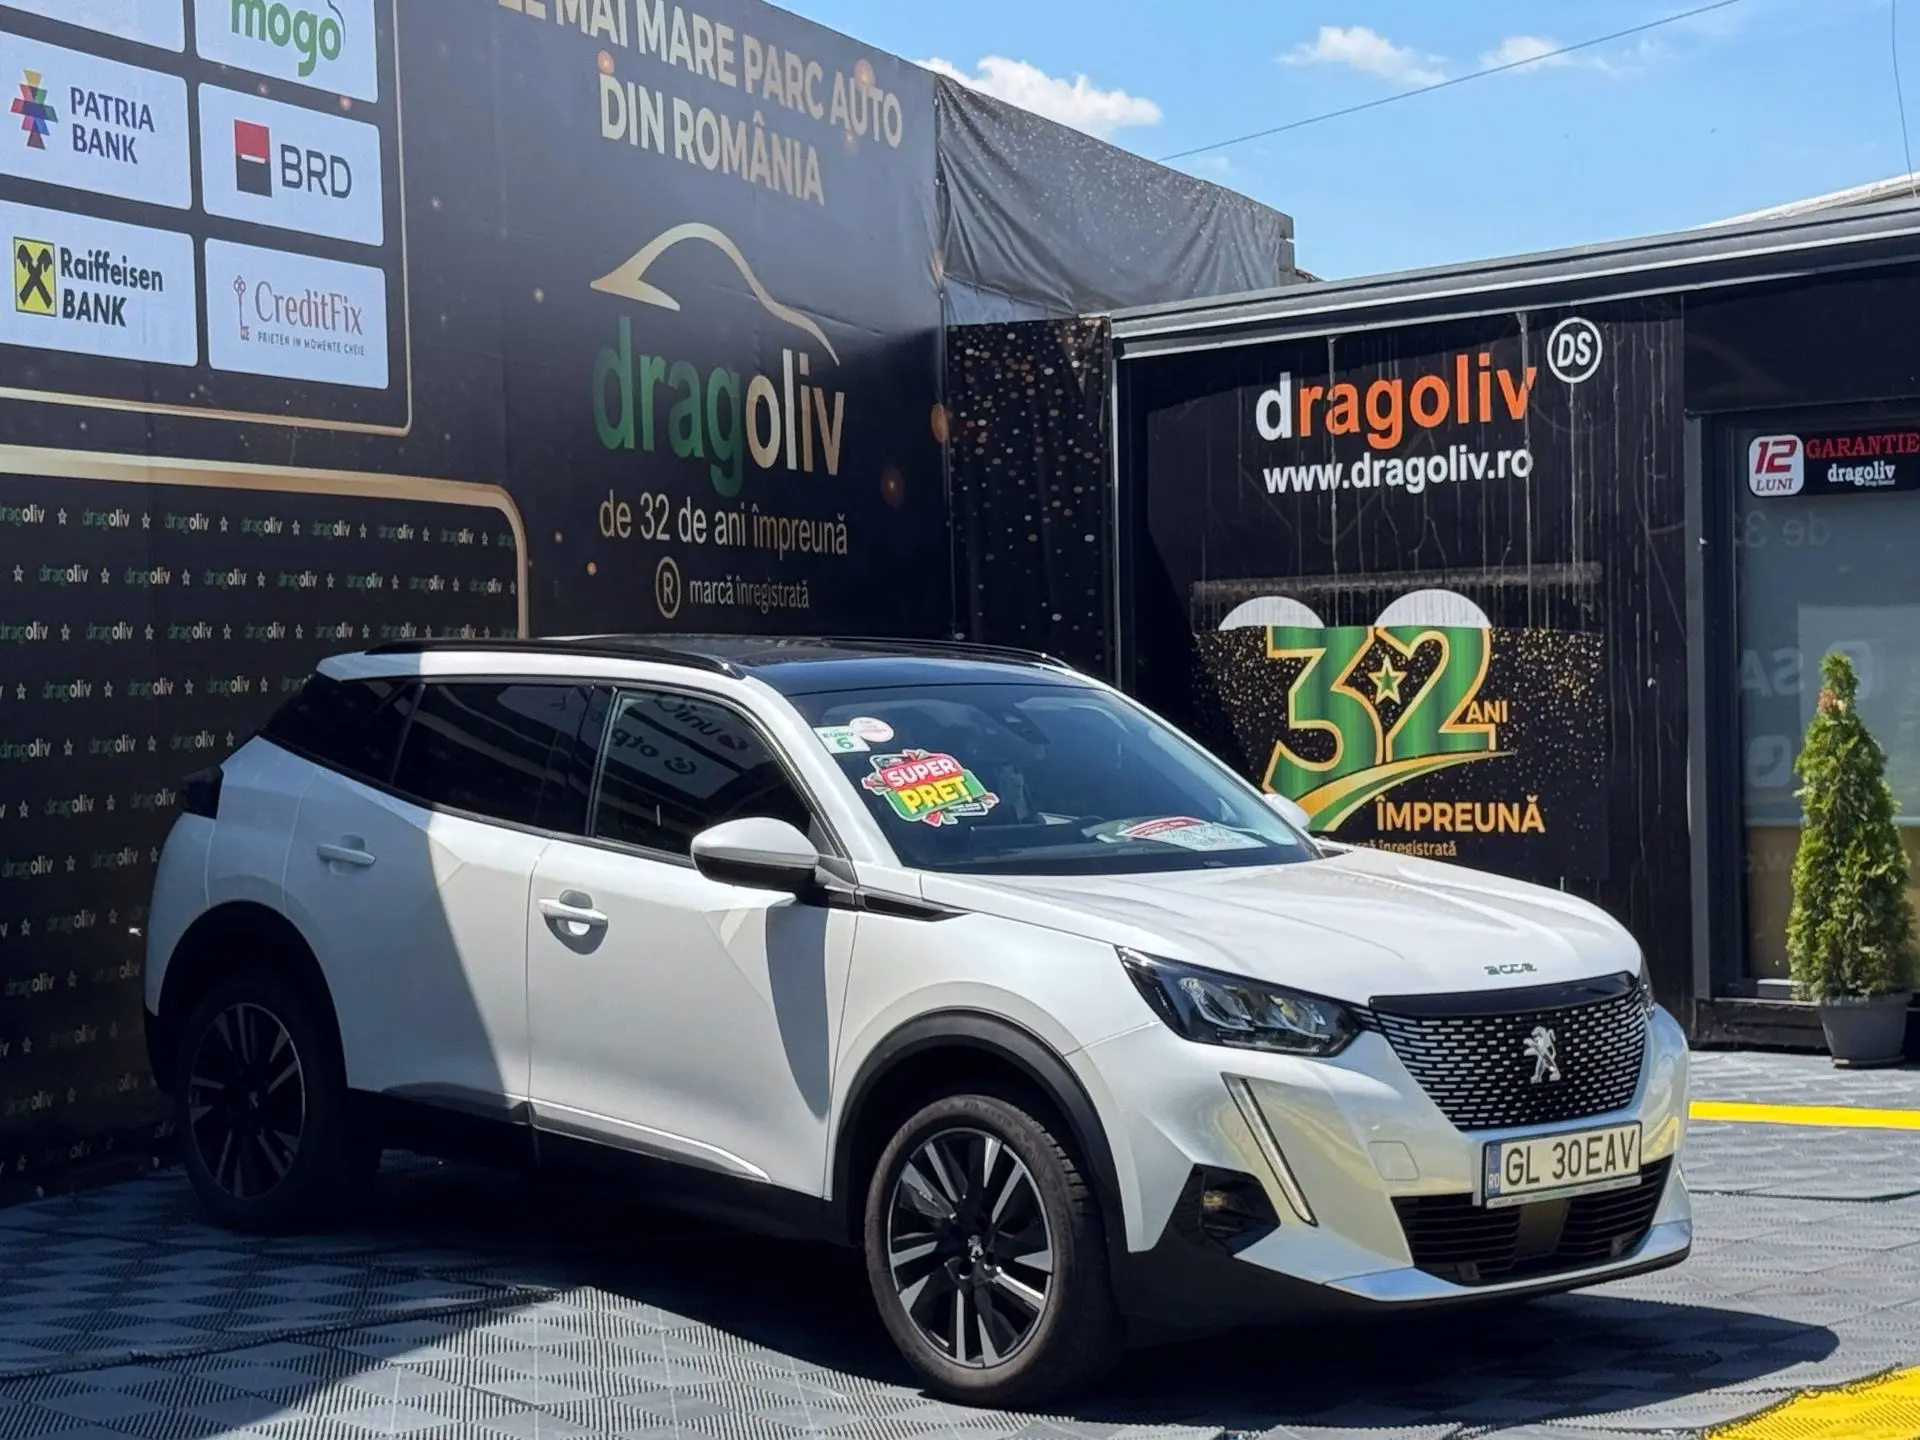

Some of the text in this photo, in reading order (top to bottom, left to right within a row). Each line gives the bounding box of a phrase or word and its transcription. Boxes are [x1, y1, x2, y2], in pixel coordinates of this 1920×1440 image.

[231, 0, 342, 77] mogo
[637, 0, 738, 89] MARE
[742, 32, 824, 121] PARC
[829, 70, 903, 149] AUTO
[70, 86, 156, 133] PATRIA
[72, 123, 139, 165] BANK
[599, 73, 825, 207] DIN ROMÂNIA
[280, 143, 353, 200] BRD
[60, 247, 164, 293] Raiffeisen
[62, 288, 127, 328] BANK
[255, 280, 364, 336] CreditFix
[1556, 330, 1594, 368] DS
[592, 315, 846, 497] dragoliv
[1255, 351, 1538, 450] dragoliv
[1754, 439, 1798, 475] 12
[1805, 431, 1920, 460] GARANTIE
[1263, 444, 1534, 495] www.dragoliv.ro
[1755, 477, 1795, 492] LUNI
[1827, 459, 1897, 487] dragoliv
[0, 503, 46, 528] ragoliv
[82, 506, 131, 532] dragoliv
[164, 511, 210, 535] dragoliv
[240, 515, 284, 538] dragoliv
[600, 489, 848, 561] de 32 de ani împreună
[38, 563, 89, 588] dragoliv
[124, 566, 171, 590] dragoliv
[203, 567, 248, 591] dragoliv
[689, 575, 735, 606] marcă
[737, 575, 810, 614] înregistrată
[85, 620, 134, 645] dragoliv
[167, 620, 213, 644] dragoliv
[42, 678, 92, 703] dragoliv
[127, 676, 175, 700] dragoliv
[1262, 626, 1497, 802] 32
[1465, 699, 1508, 725] ANI
[886, 757, 959, 788] SUPER
[1376, 794, 1547, 834] ÎMPREUNĂ
[1505, 1144, 1541, 1187] GL
